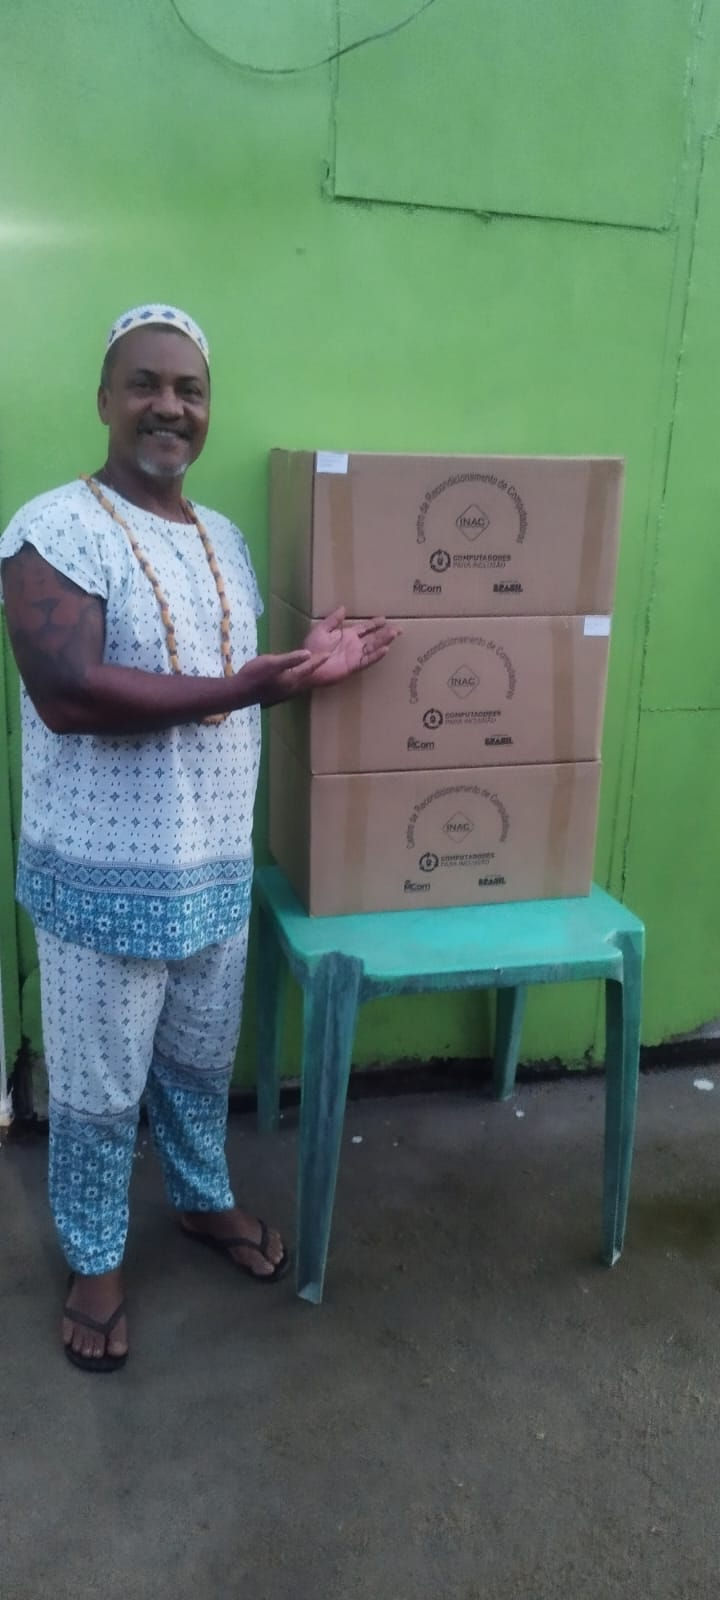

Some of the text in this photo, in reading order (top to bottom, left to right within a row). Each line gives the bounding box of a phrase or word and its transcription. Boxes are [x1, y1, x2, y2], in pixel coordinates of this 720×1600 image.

[459, 518, 485, 528] INAC
[451, 678, 476, 687] INAC
[447, 824, 470, 832] INAC
